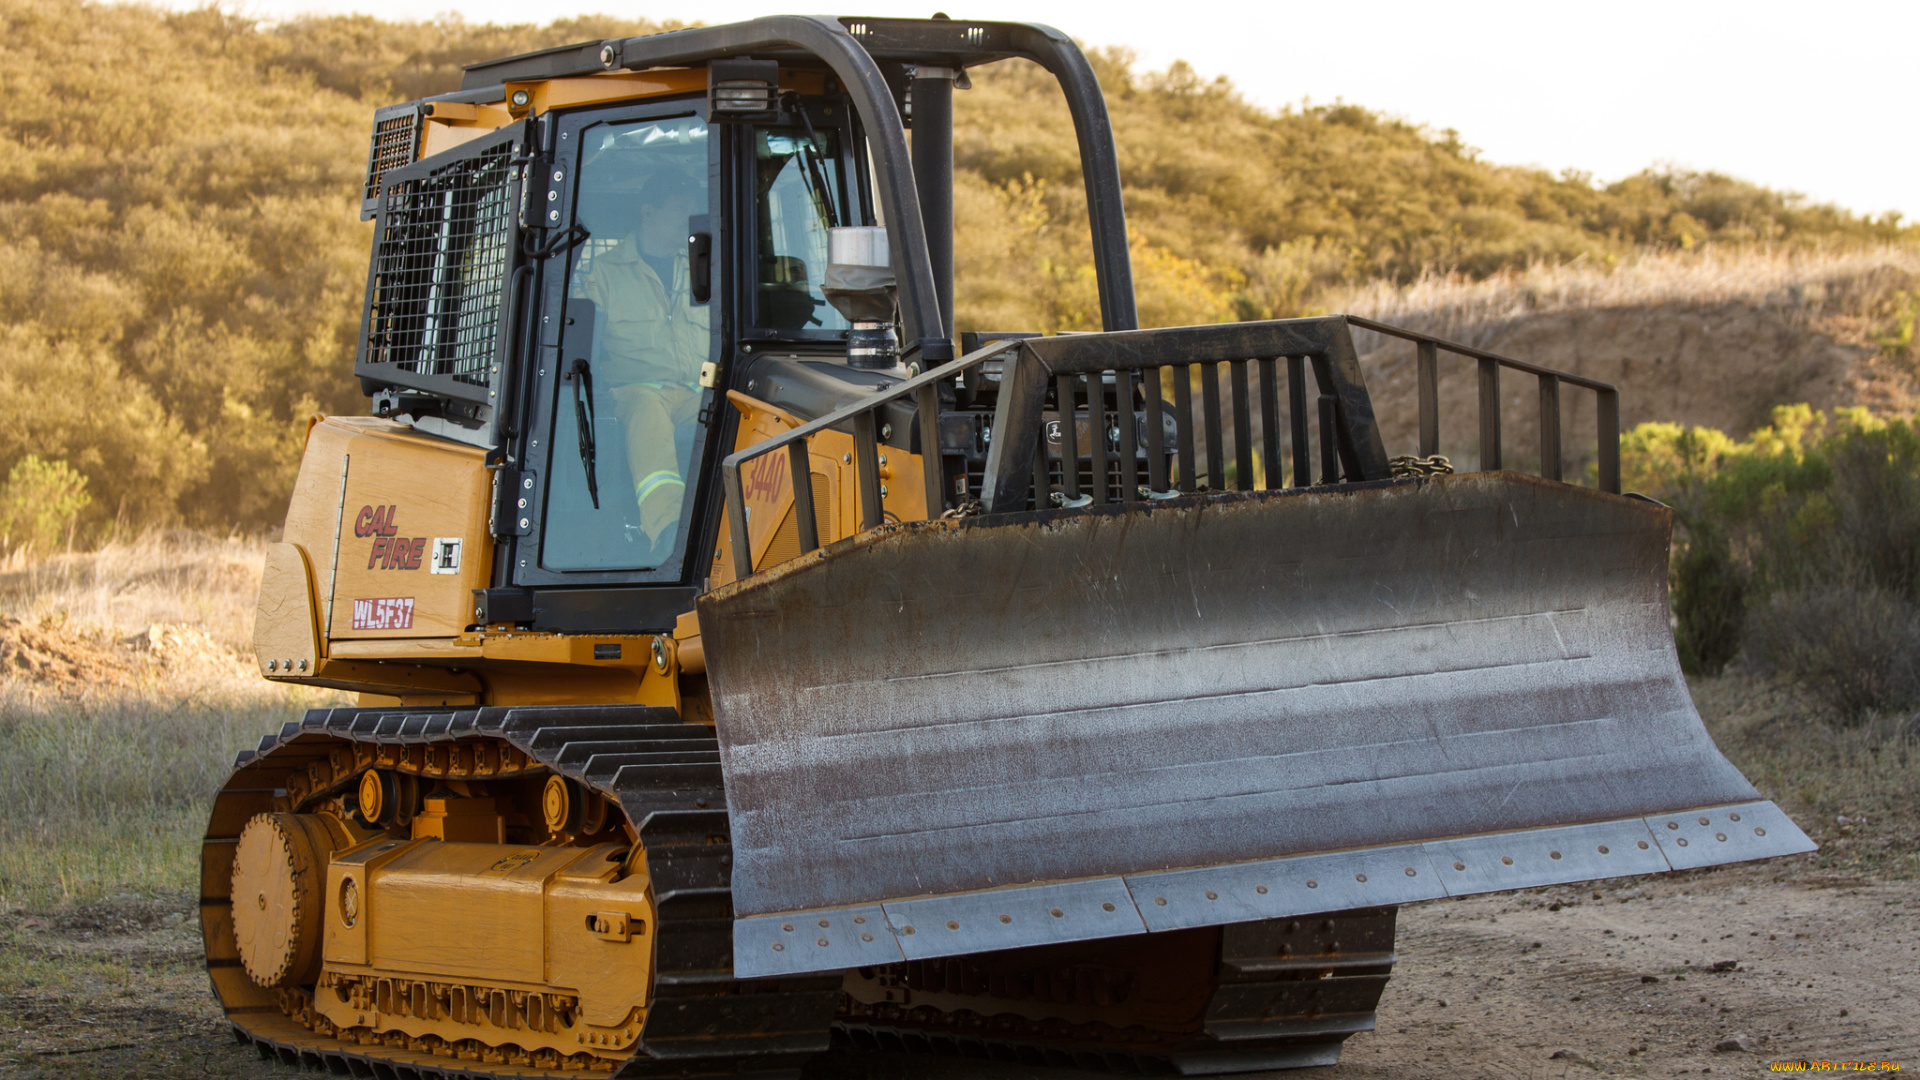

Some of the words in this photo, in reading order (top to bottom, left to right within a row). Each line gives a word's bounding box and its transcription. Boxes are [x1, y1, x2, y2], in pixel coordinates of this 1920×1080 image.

[745, 452, 785, 504] 3440
[354, 505, 398, 538] CAL
[367, 537, 427, 570] FIRE
[354, 598, 414, 629] WL5F37
